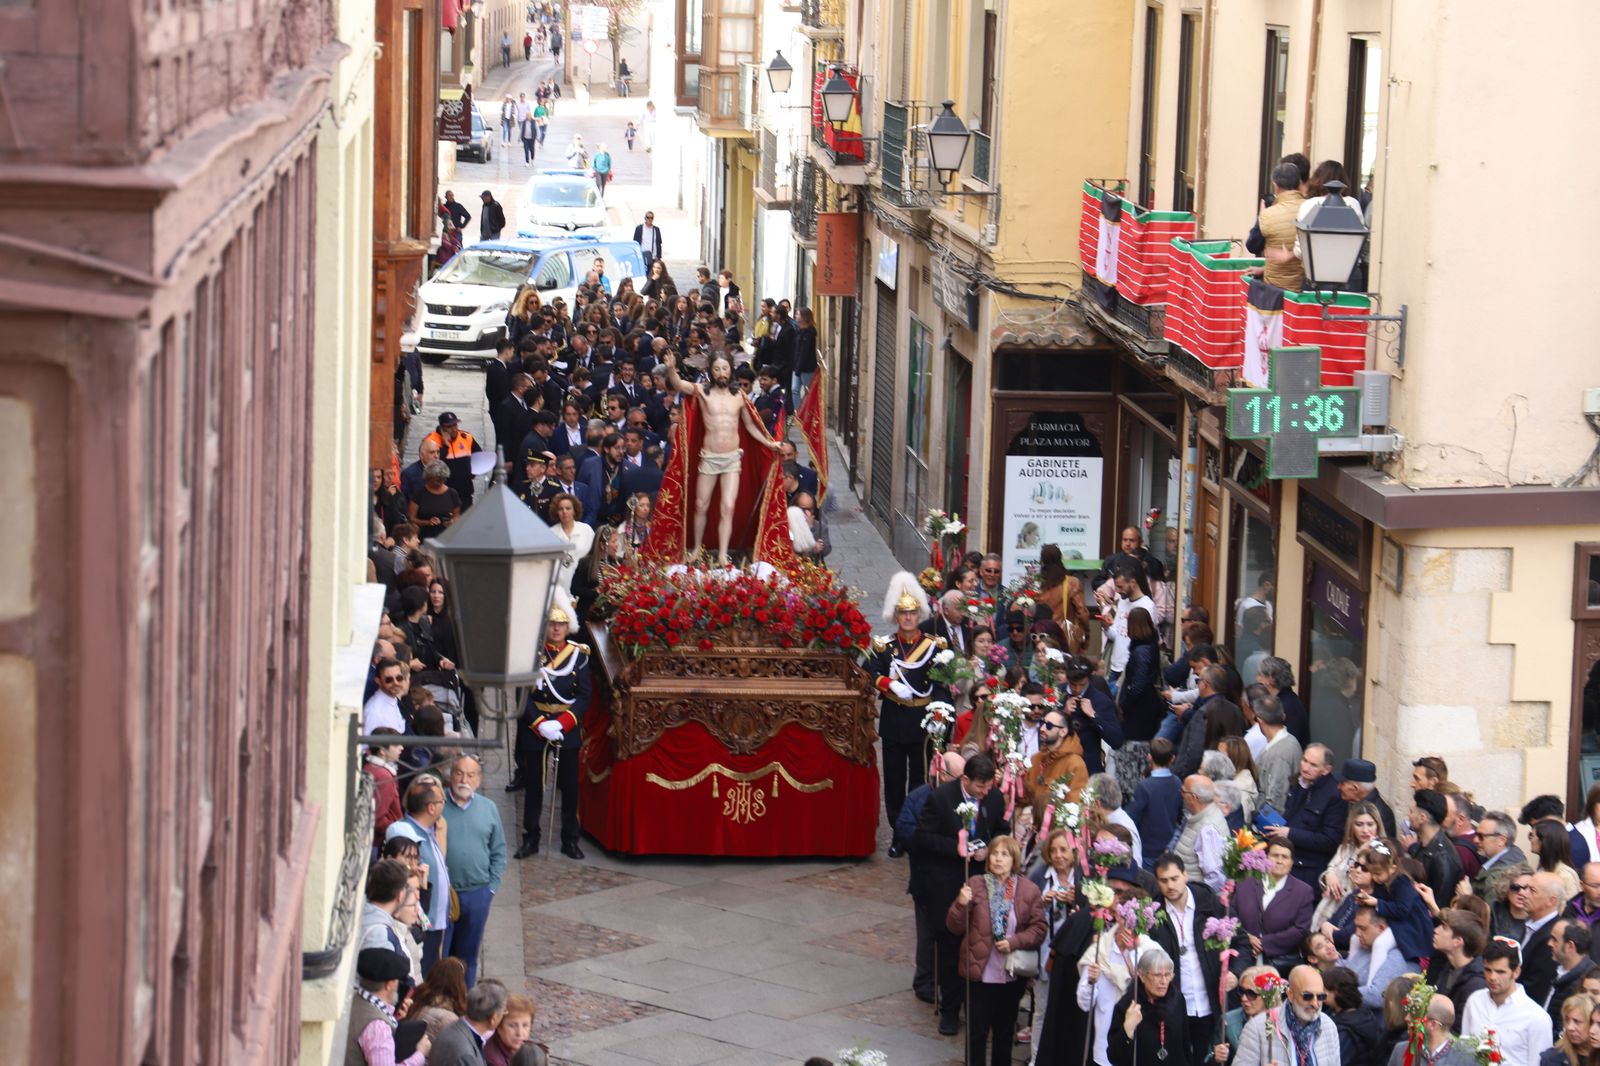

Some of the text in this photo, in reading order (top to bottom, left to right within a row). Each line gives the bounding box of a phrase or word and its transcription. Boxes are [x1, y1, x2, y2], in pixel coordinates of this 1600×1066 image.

[1245, 394, 1344, 433] 11:36
[1030, 423, 1081, 432] FARMACIA
[1019, 437, 1090, 447] PLAZA MAYOR
[1027, 459, 1081, 469] GABINETE
[1019, 468, 1089, 479] AUDIOLOGIA
